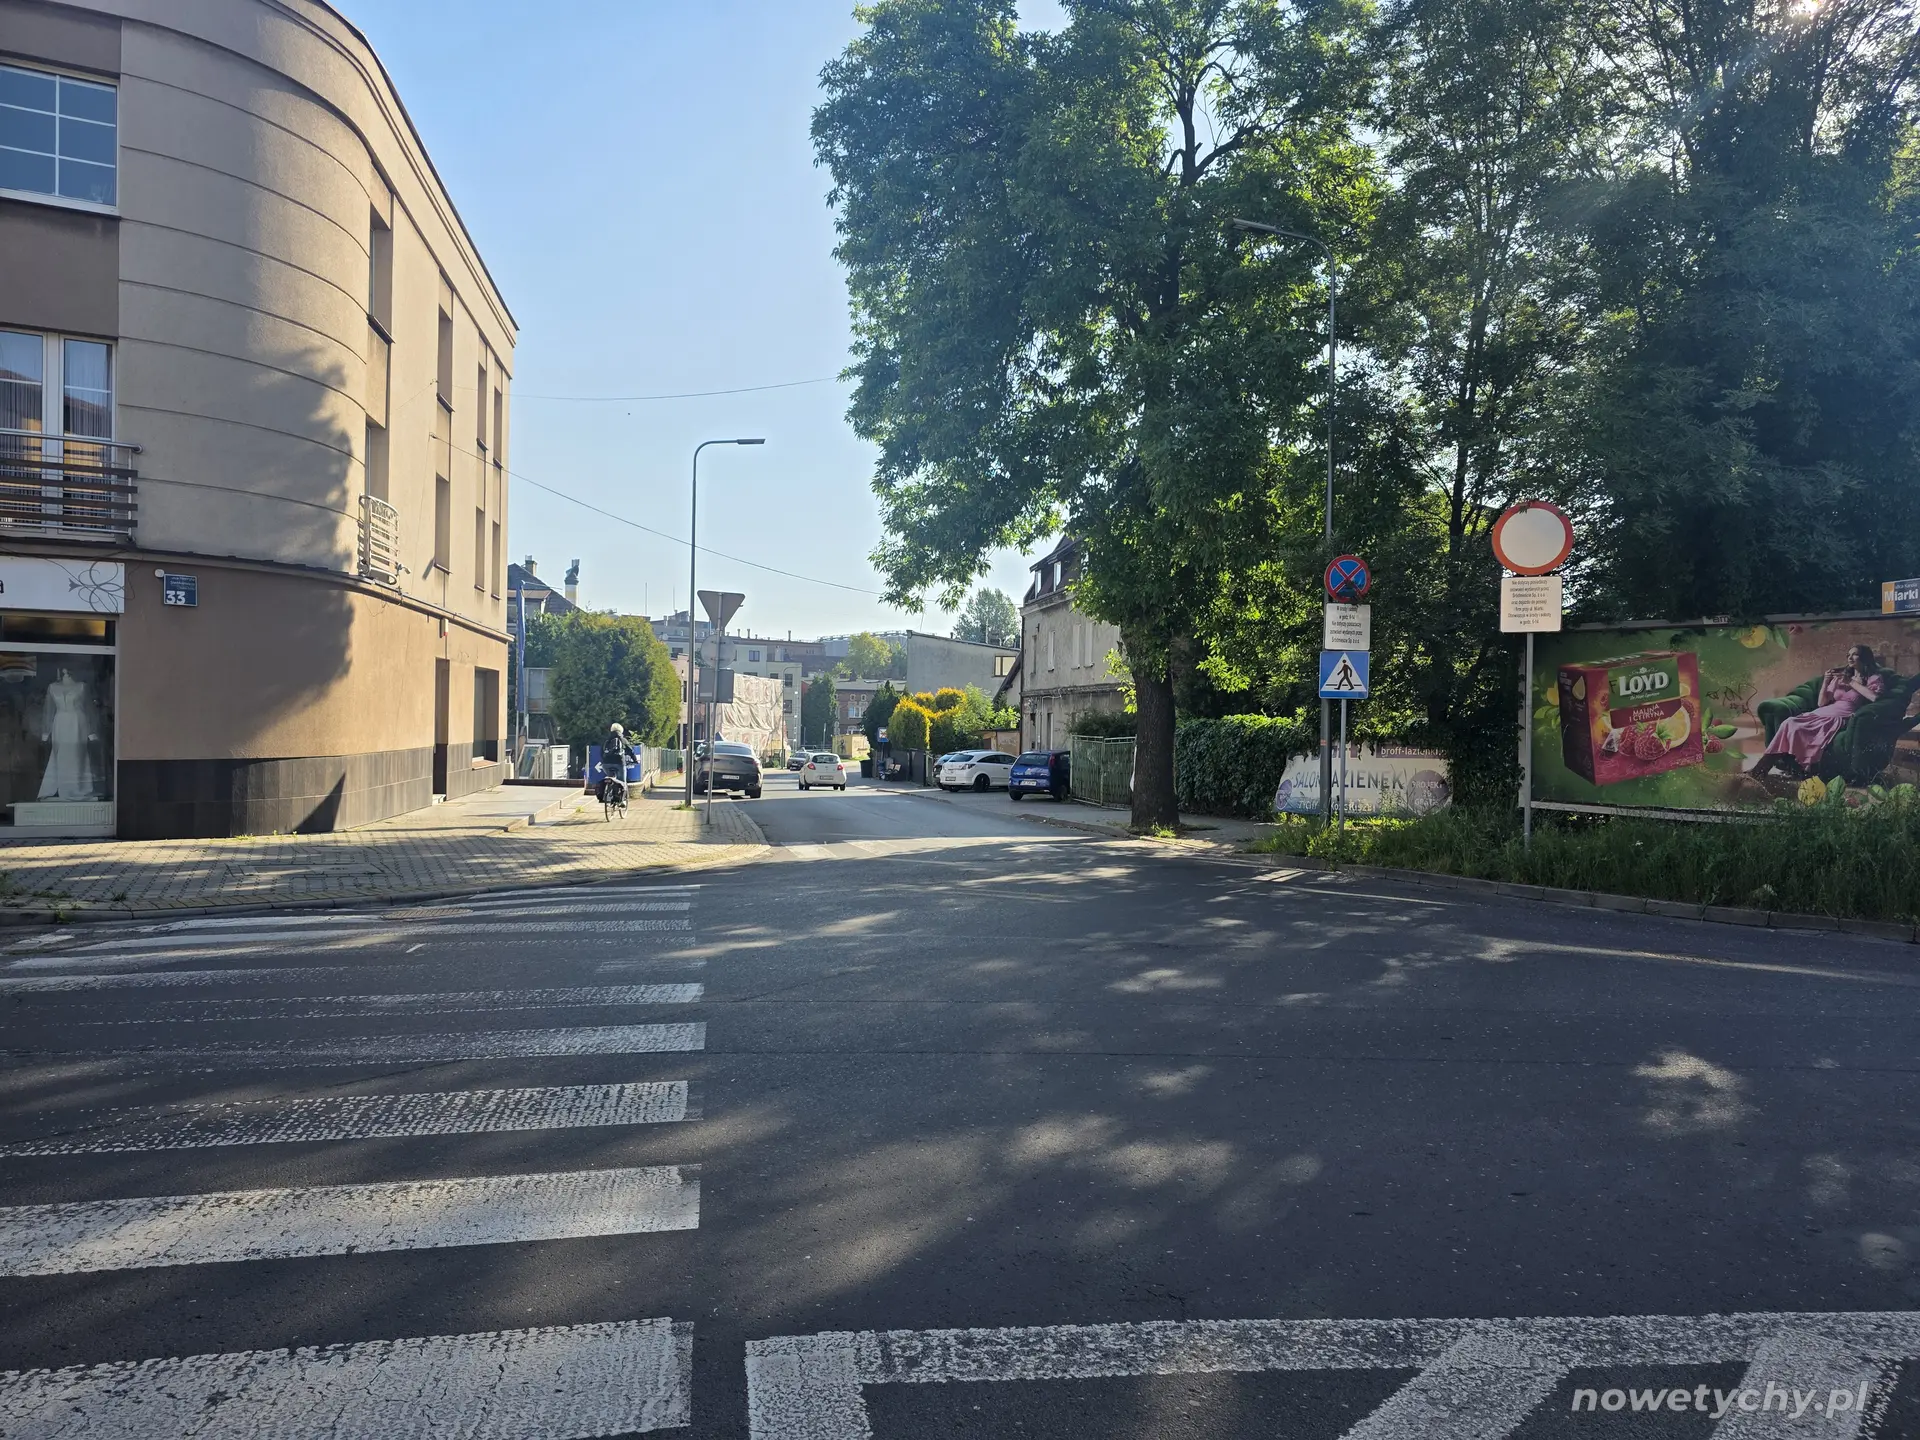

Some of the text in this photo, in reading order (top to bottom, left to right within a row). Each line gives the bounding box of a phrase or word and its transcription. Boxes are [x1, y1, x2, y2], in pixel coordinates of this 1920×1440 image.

[166, 590, 186, 604] 33
[1884, 588, 1919, 602] Miarki
[1619, 671, 1670, 697] LOYD
[1632, 703, 1660, 717] MALINA
[1633, 710, 1665, 722] CYTRYNA
